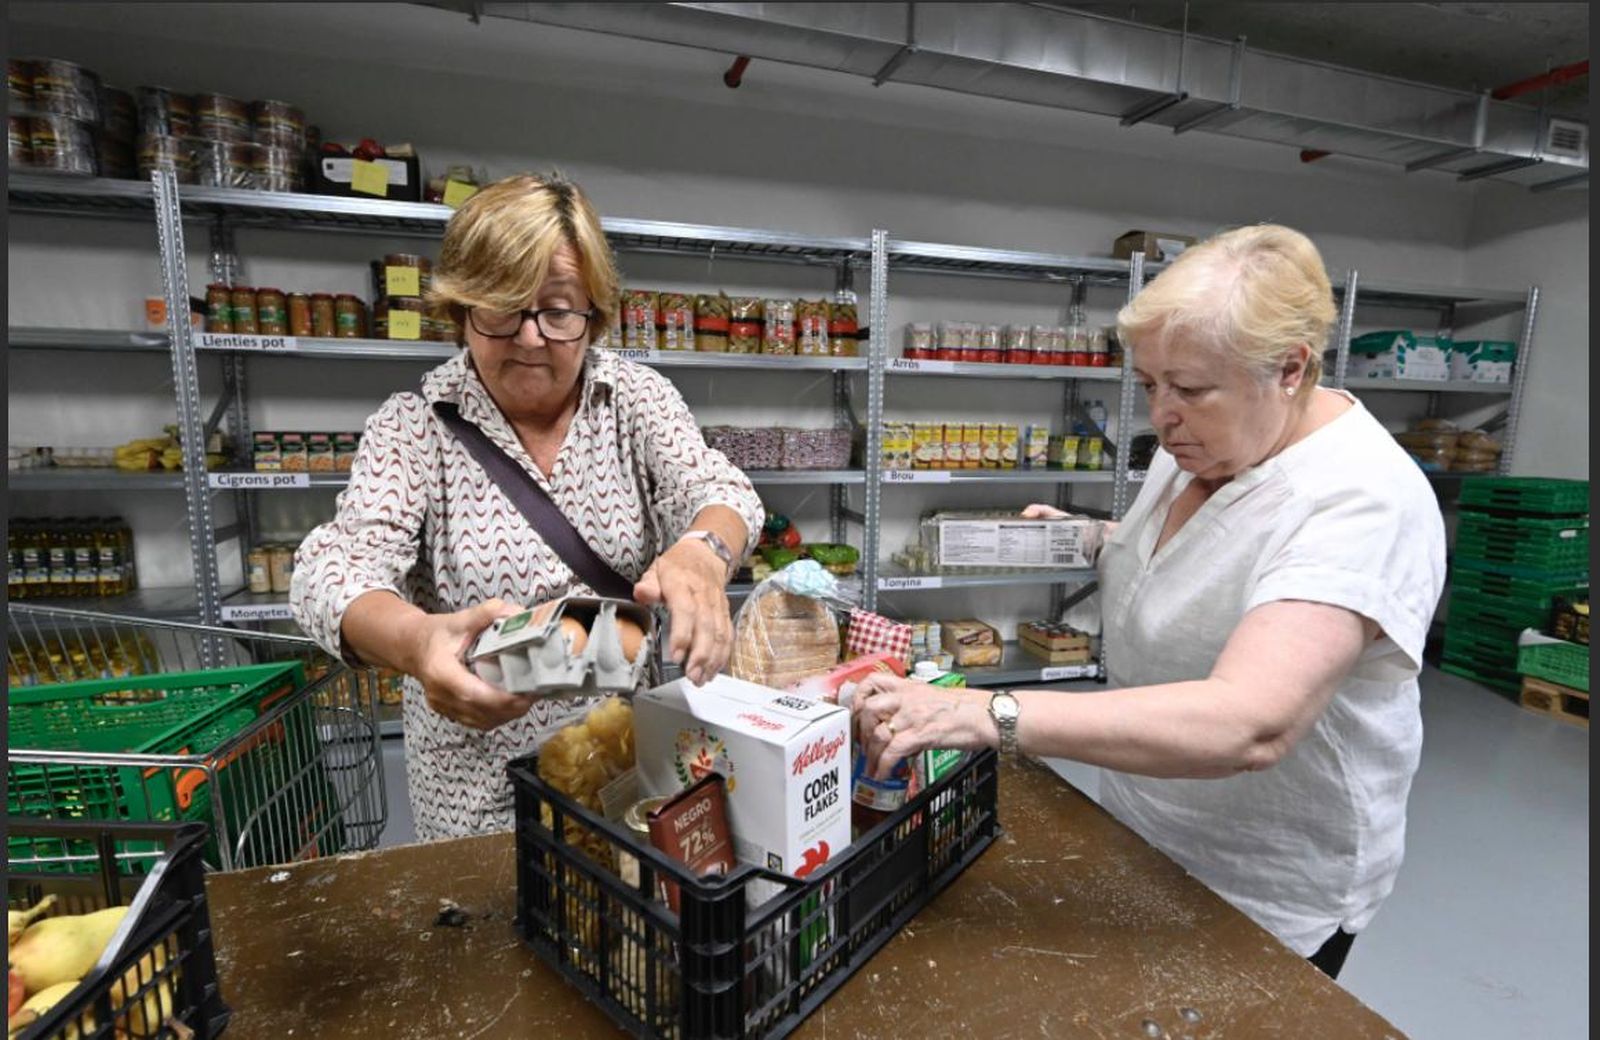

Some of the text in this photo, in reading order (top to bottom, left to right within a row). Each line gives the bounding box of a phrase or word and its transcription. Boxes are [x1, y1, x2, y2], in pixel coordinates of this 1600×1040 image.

[202, 335, 286, 349] Llenties pot
[613, 349, 650, 359] rrons
[217, 474, 297, 488] Cigrons pot
[890, 470, 915, 480] Brou
[883, 578, 922, 589] Tonyina
[792, 729, 847, 776] Kellogg's
[803, 766, 840, 805] CORN
[673, 797, 713, 835] NEGRO
[804, 788, 840, 822] FLAKES
[680, 827, 716, 863] 72%
